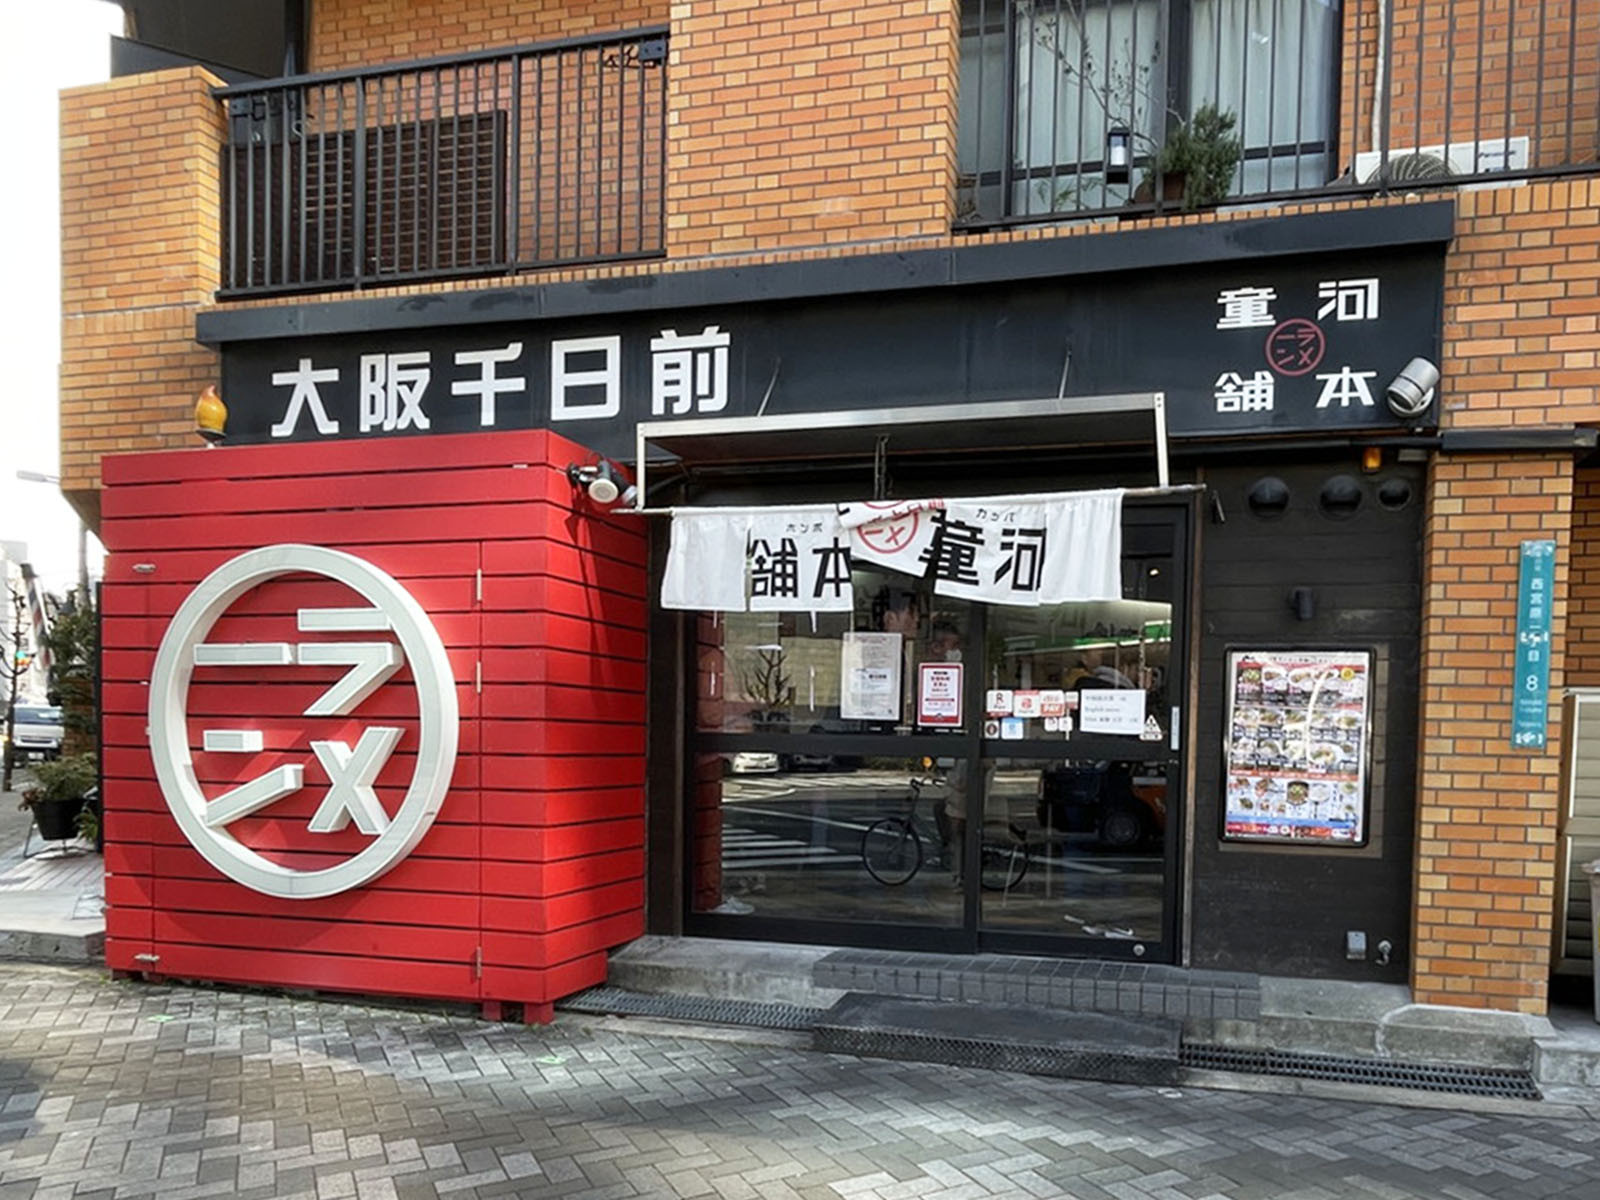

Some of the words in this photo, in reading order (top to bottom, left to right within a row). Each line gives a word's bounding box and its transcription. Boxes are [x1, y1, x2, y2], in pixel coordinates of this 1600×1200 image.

[271, 325, 731, 437] 大阪千日前
[1525, 674, 1538, 692] 8
